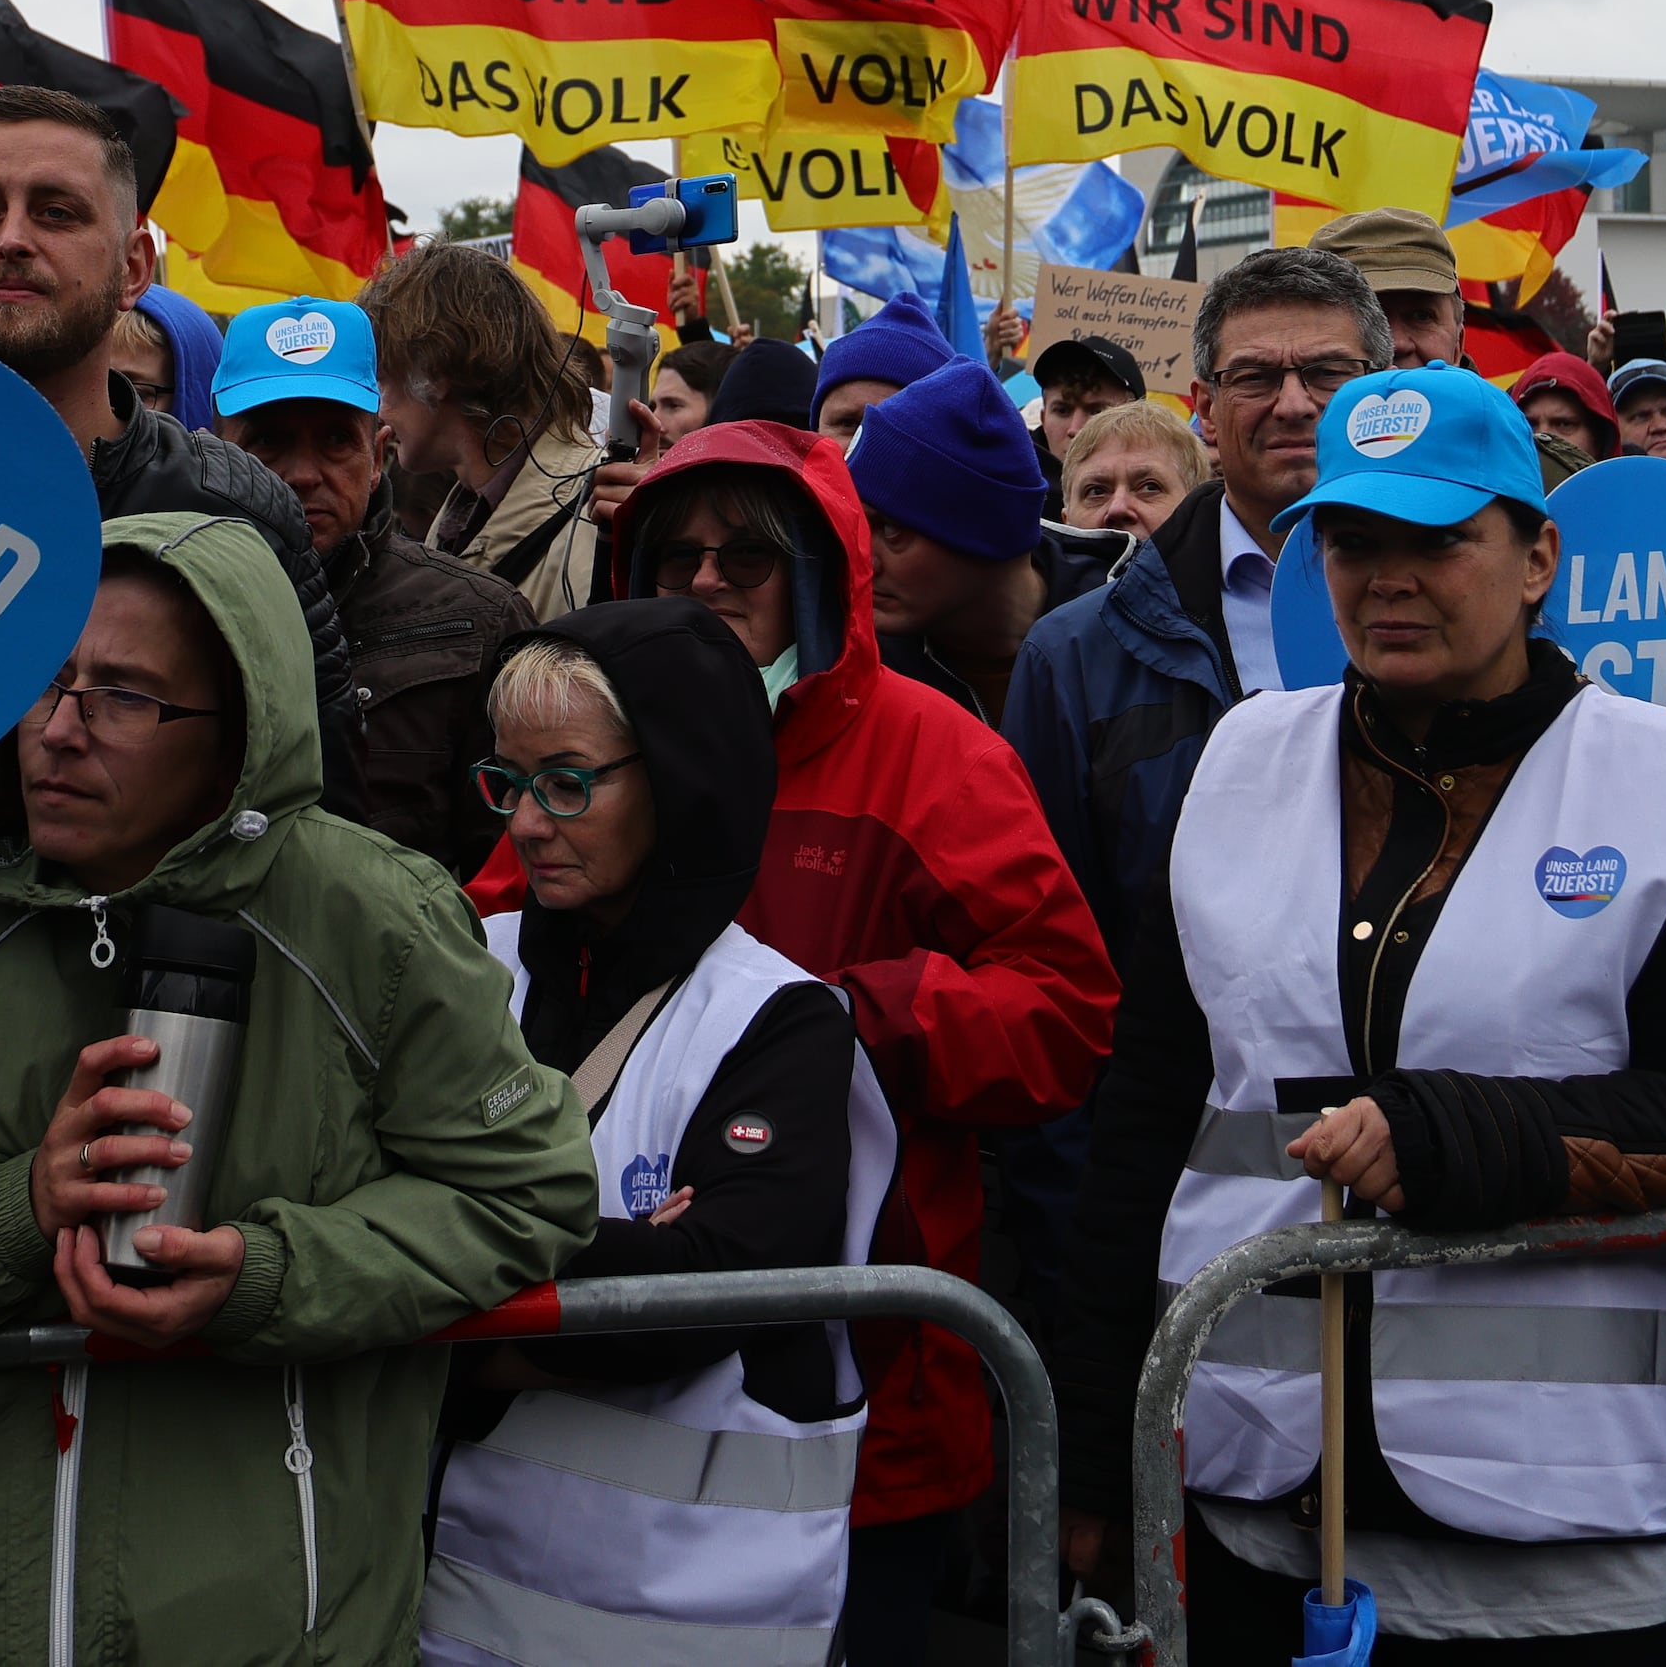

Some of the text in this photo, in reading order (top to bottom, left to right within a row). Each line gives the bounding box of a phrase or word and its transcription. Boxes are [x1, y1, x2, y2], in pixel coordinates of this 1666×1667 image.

[801, 53, 946, 108] VOLK
[416, 56, 690, 135] DAS VOLK
[1075, 78, 1347, 179] DAS VOLK
[1051, 273, 1188, 314] Wer Waffen liefert,
[1055, 306, 1079, 320] soll
[1082, 310, 1111, 323] auch
[275, 321, 328, 339] UNSER LAND
[276, 331, 330, 352] ZUERST!
[1356, 402, 1422, 422] UNSER LAND
[1353, 415, 1419, 440] ZUERST!
[794, 844, 824, 858] Jack
[1545, 859, 1618, 874] UNSER LAND
[1542, 873, 1615, 893] ZUERST!
[487, 1088, 511, 1109] CECIL
[489, 1083, 530, 1119] OUTERWEAR
